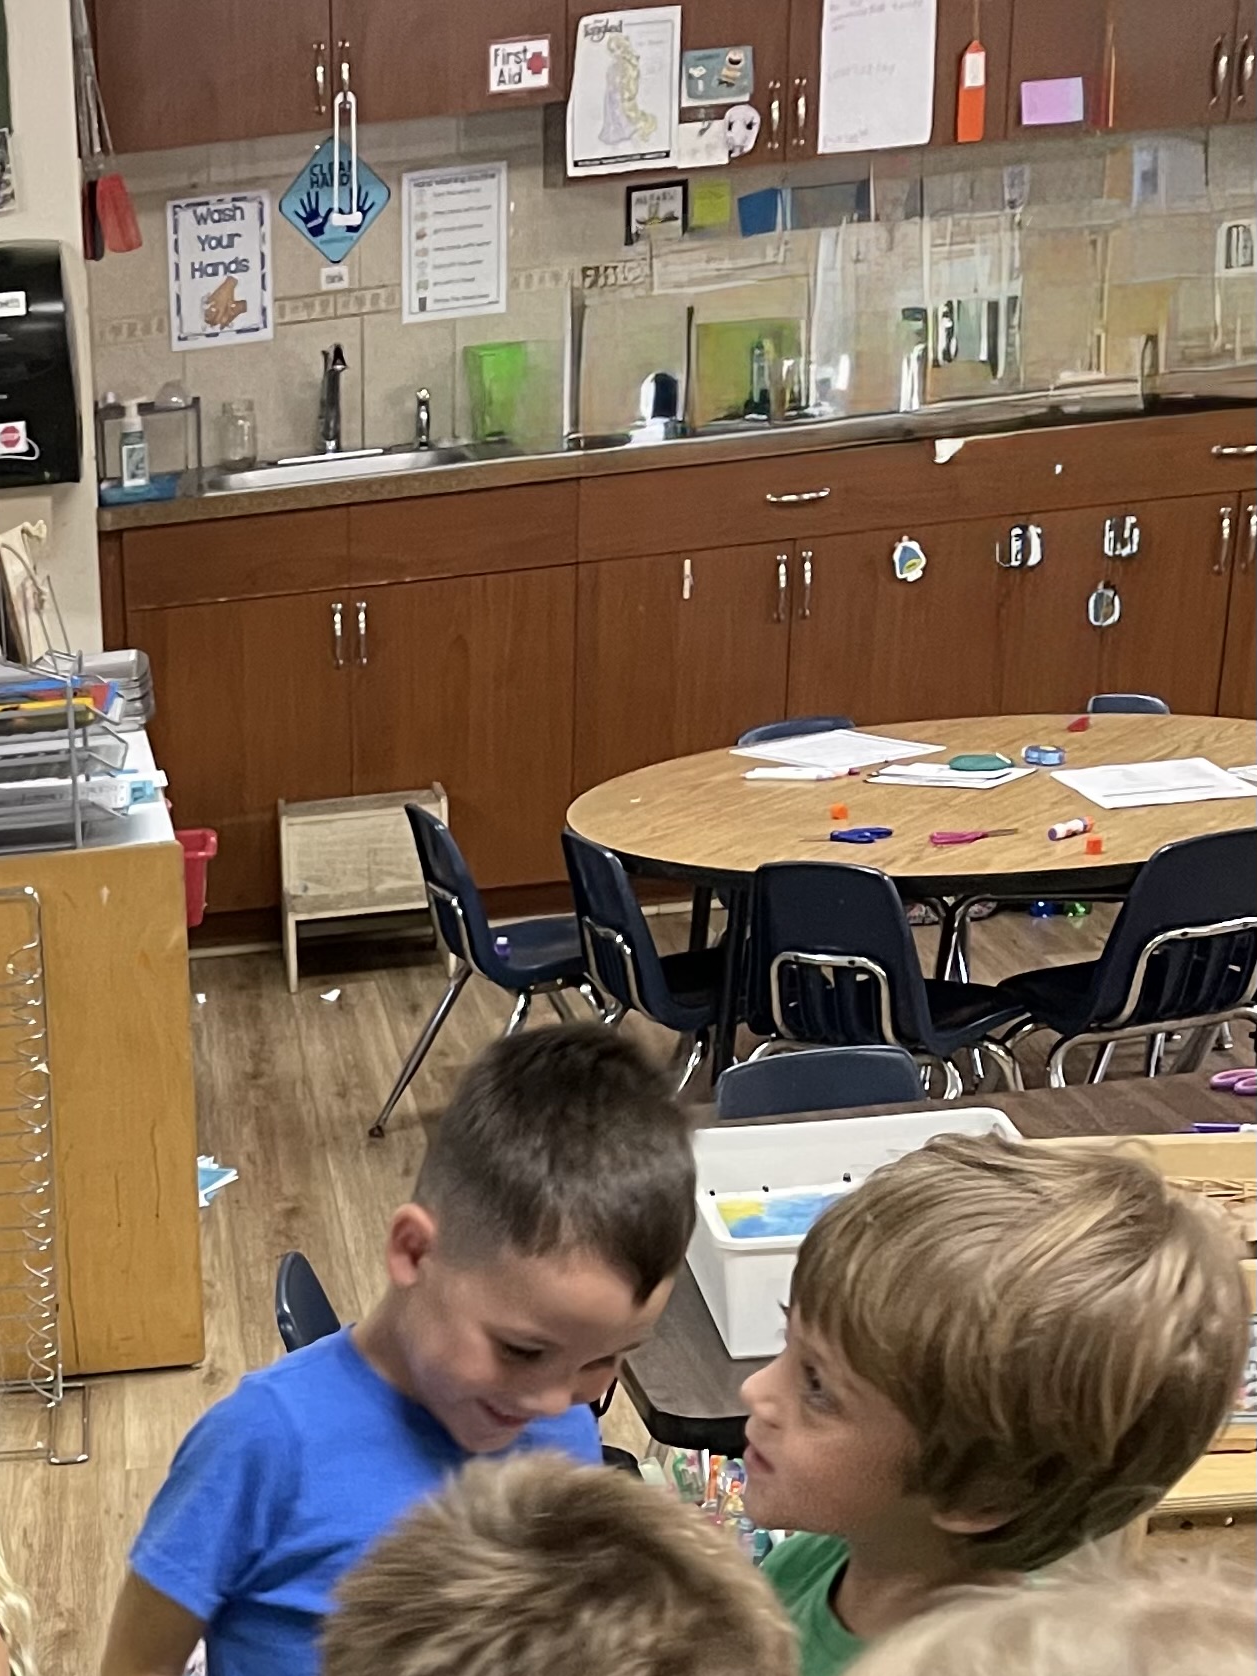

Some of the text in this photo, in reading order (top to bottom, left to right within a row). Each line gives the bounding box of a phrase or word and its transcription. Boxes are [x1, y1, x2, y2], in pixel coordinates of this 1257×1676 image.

[494, 46, 528, 67] First
[497, 66, 522, 86] Aid
[310, 160, 353, 177] CLEA
[193, 203, 245, 226] Wash
[197, 233, 242, 252] Your
[190, 256, 250, 279] Hands
